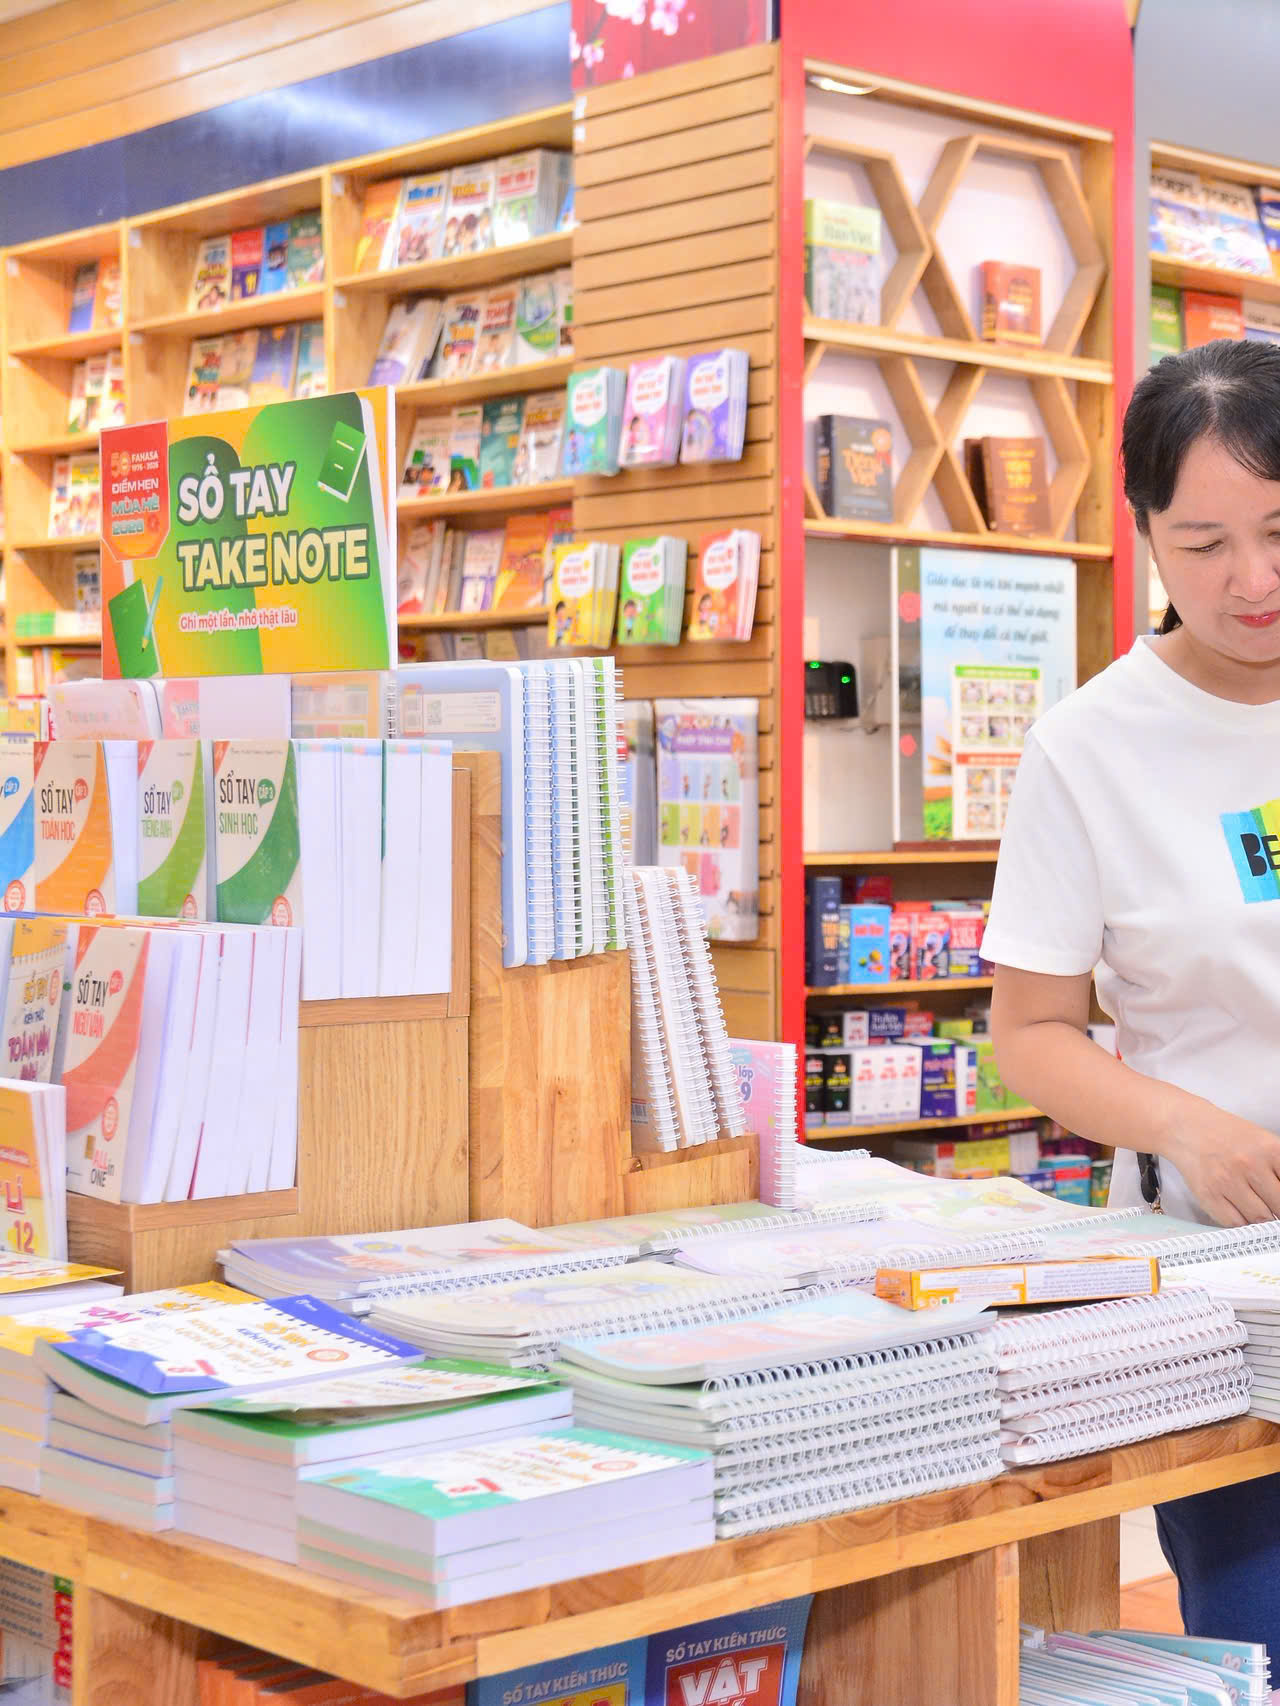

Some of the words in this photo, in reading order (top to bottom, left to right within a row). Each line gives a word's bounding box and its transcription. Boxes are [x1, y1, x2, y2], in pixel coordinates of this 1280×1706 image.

[131, 450, 159, 463] FAHASA
[111, 478, 137, 494] ĐIỂM
[137, 478, 159, 493] HẸN
[178, 453, 224, 522] SỔ
[229, 466, 295, 517] TAY
[111, 495, 141, 515] MÙA
[177, 537, 267, 589] TAKE
[273, 528, 369, 582] NOTE
[180, 613, 197, 630] Ghi
[199, 611, 217, 632] một
[238, 610, 257, 626] nhớ
[258, 609, 279, 627] thật
[281, 610, 296, 624] lâu
[41, 780, 53, 814] SỔ
[56, 789, 74, 814] TAY
[144, 783, 155, 814] SỔ
[156, 791, 172, 815] TAY
[219, 769, 234, 804] SỔ
[235, 778, 256, 805] TAY
[41, 817, 60, 840] TOÁN
[61, 821, 76, 844] HỌC
[219, 812, 239, 834] SINH
[241, 812, 258, 839] HỌC
[77, 971, 91, 1005] SỔ
[92, 979, 110, 1008] TAY
[738, 1065, 753, 1081] lớp
[740, 1081, 752, 1101] 9
[92, 1149, 108, 1171] ALL
[90, 1168, 107, 1188] ONE
[14, 1219, 35, 1254] 12
[687, 1638, 712, 1657] TAY
[749, 1625, 788, 1645] THỨC
[525, 1679, 552, 1701] TAY
[590, 1661, 629, 1685] THỨC
[680, 1657, 769, 1705] VẬT
